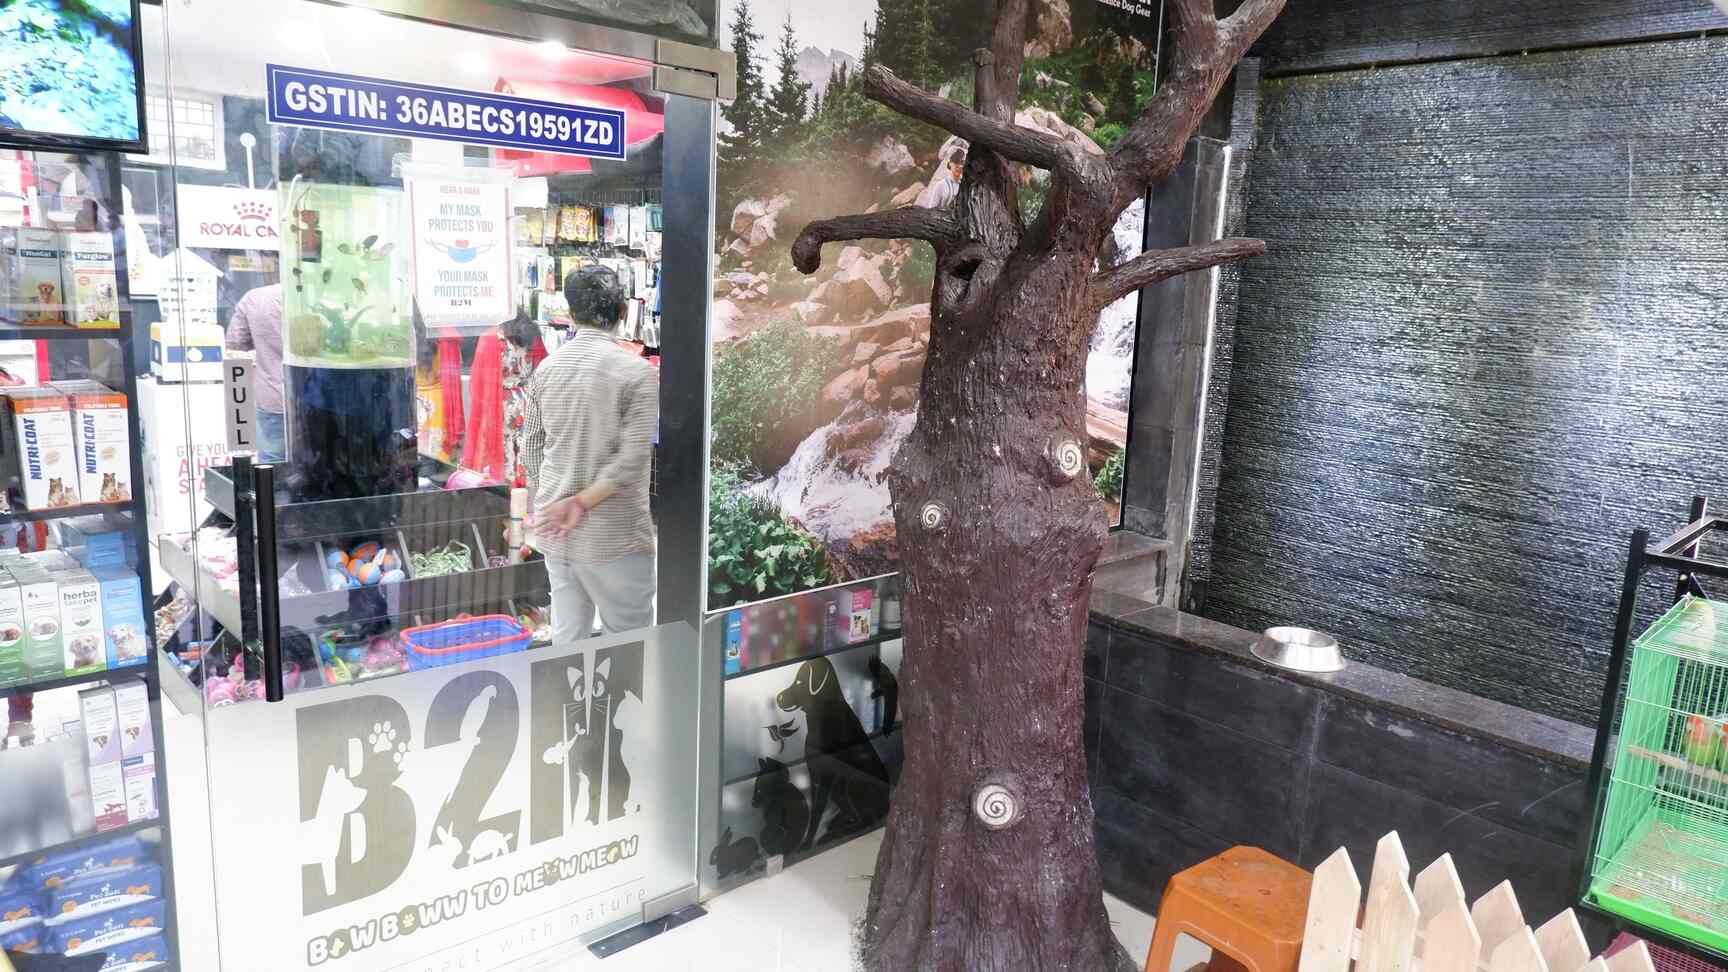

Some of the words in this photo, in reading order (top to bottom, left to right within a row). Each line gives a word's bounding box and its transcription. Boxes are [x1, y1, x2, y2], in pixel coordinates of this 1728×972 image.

[285, 81, 388, 121] GSTIN:
[396, 96, 614, 146] 36ABECS19591ZD
[440, 203, 454, 215] MY
[456, 204, 482, 216] MASK
[200, 222, 252, 237] ROYAL
[256, 225, 279, 238] CA
[428, 218, 475, 232] PROTECTS
[476, 220, 494, 233] YOU
[438, 270, 462, 282] YOUR
[464, 271, 488, 282] MASK
[434, 286, 479, 297] PROTECTS
[231, 366, 250, 446] PULL
[207, 443, 229, 455] YOU
[472, 877, 509, 910] TO
[569, 888, 649, 927] nature
